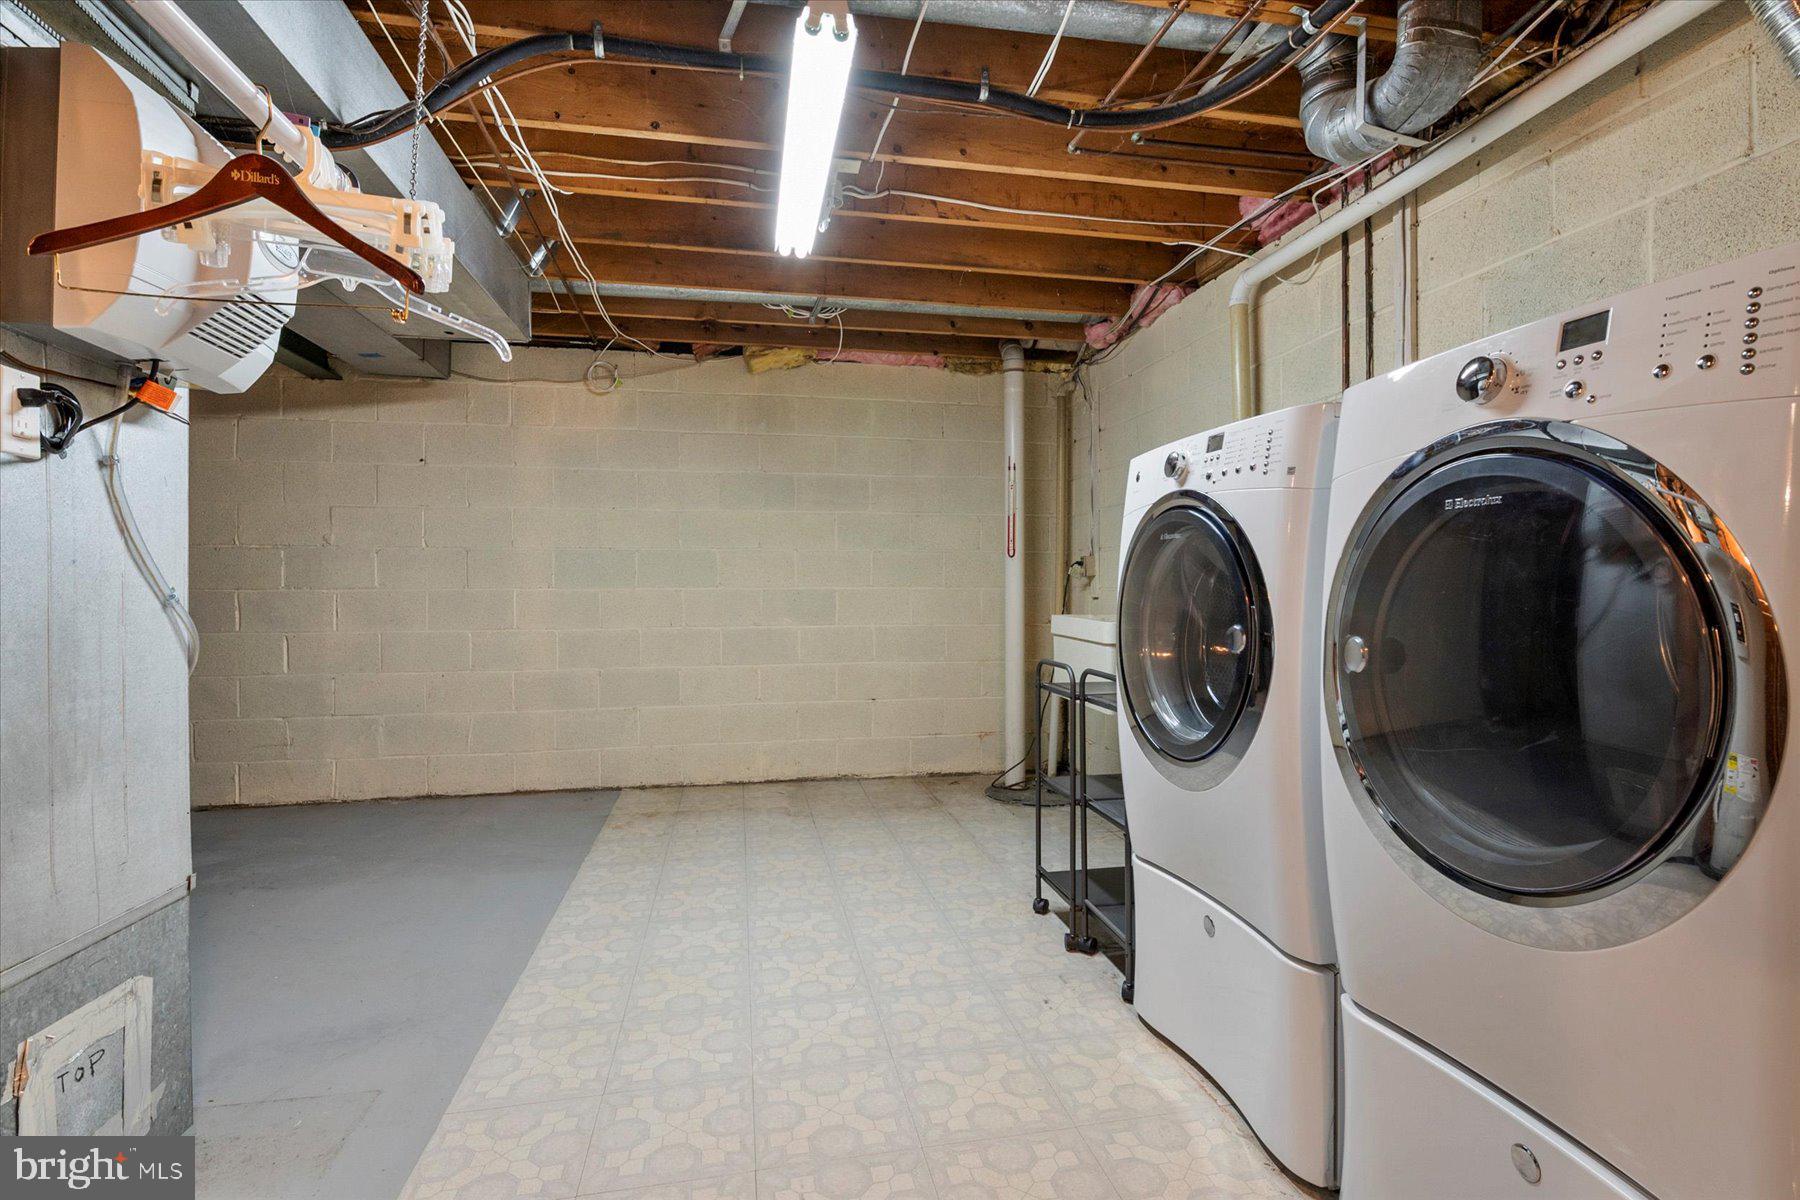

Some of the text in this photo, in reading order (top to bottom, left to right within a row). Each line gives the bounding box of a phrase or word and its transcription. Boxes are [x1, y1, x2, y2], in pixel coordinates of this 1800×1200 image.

[241, 169, 280, 185] Dillard's
[1454, 495, 1502, 509] Electrolux
[57, 1049, 106, 1093] TOP
